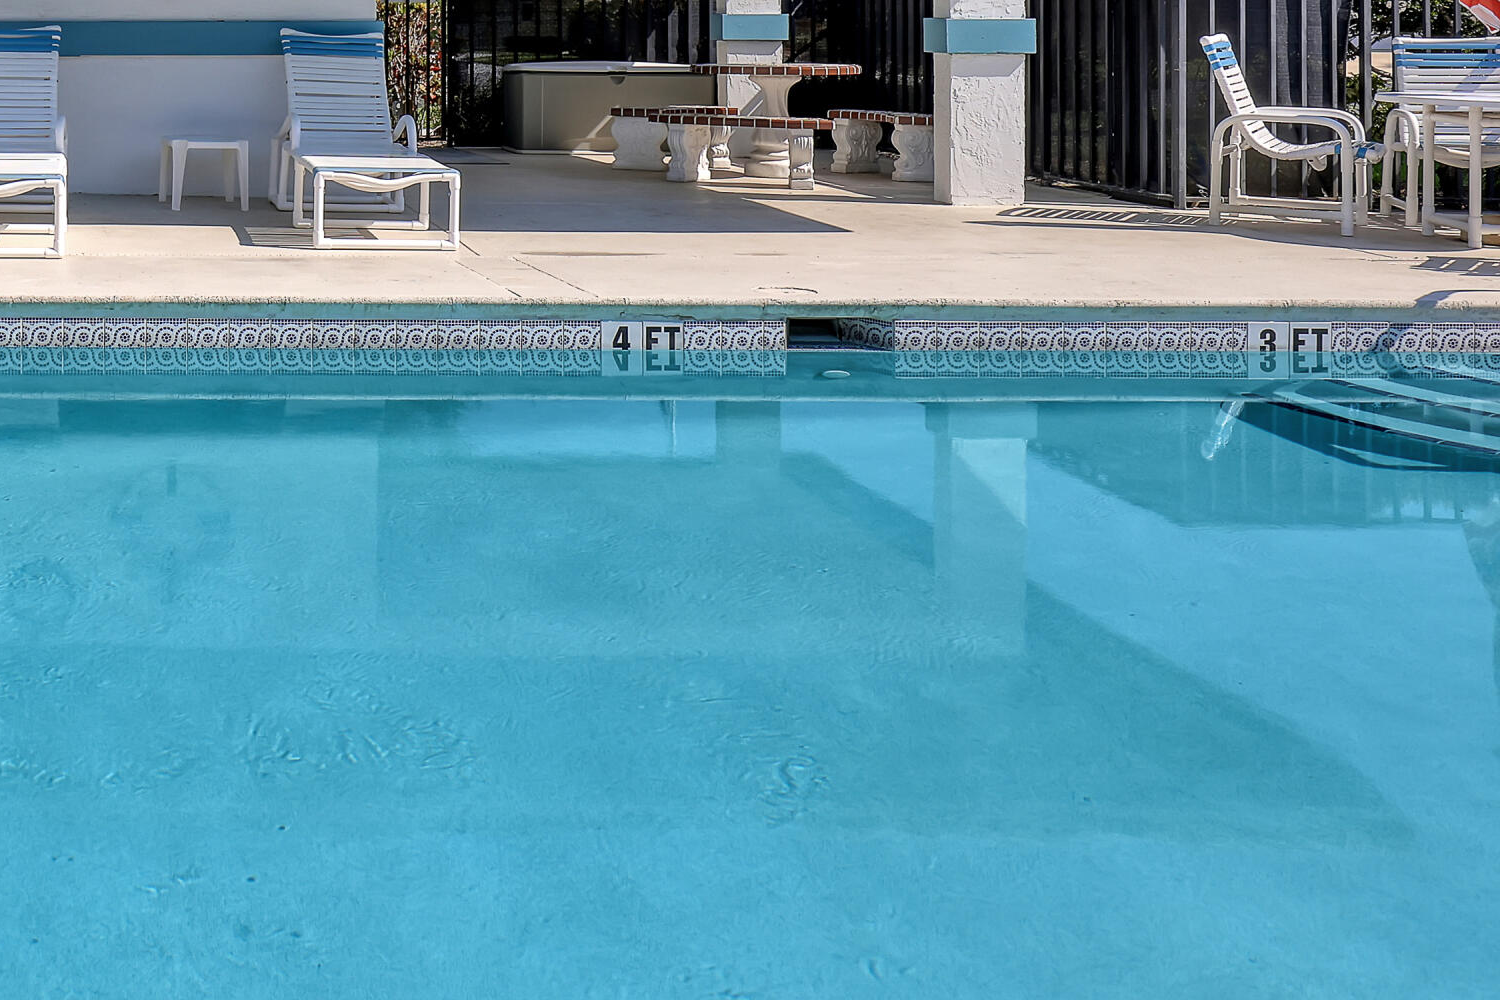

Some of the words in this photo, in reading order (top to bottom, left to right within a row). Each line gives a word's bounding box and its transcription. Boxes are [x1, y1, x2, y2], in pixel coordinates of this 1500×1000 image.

[613, 326, 631, 350] 4
[1260, 329, 1276, 352] 3
[1293, 329, 1328, 352] FT
